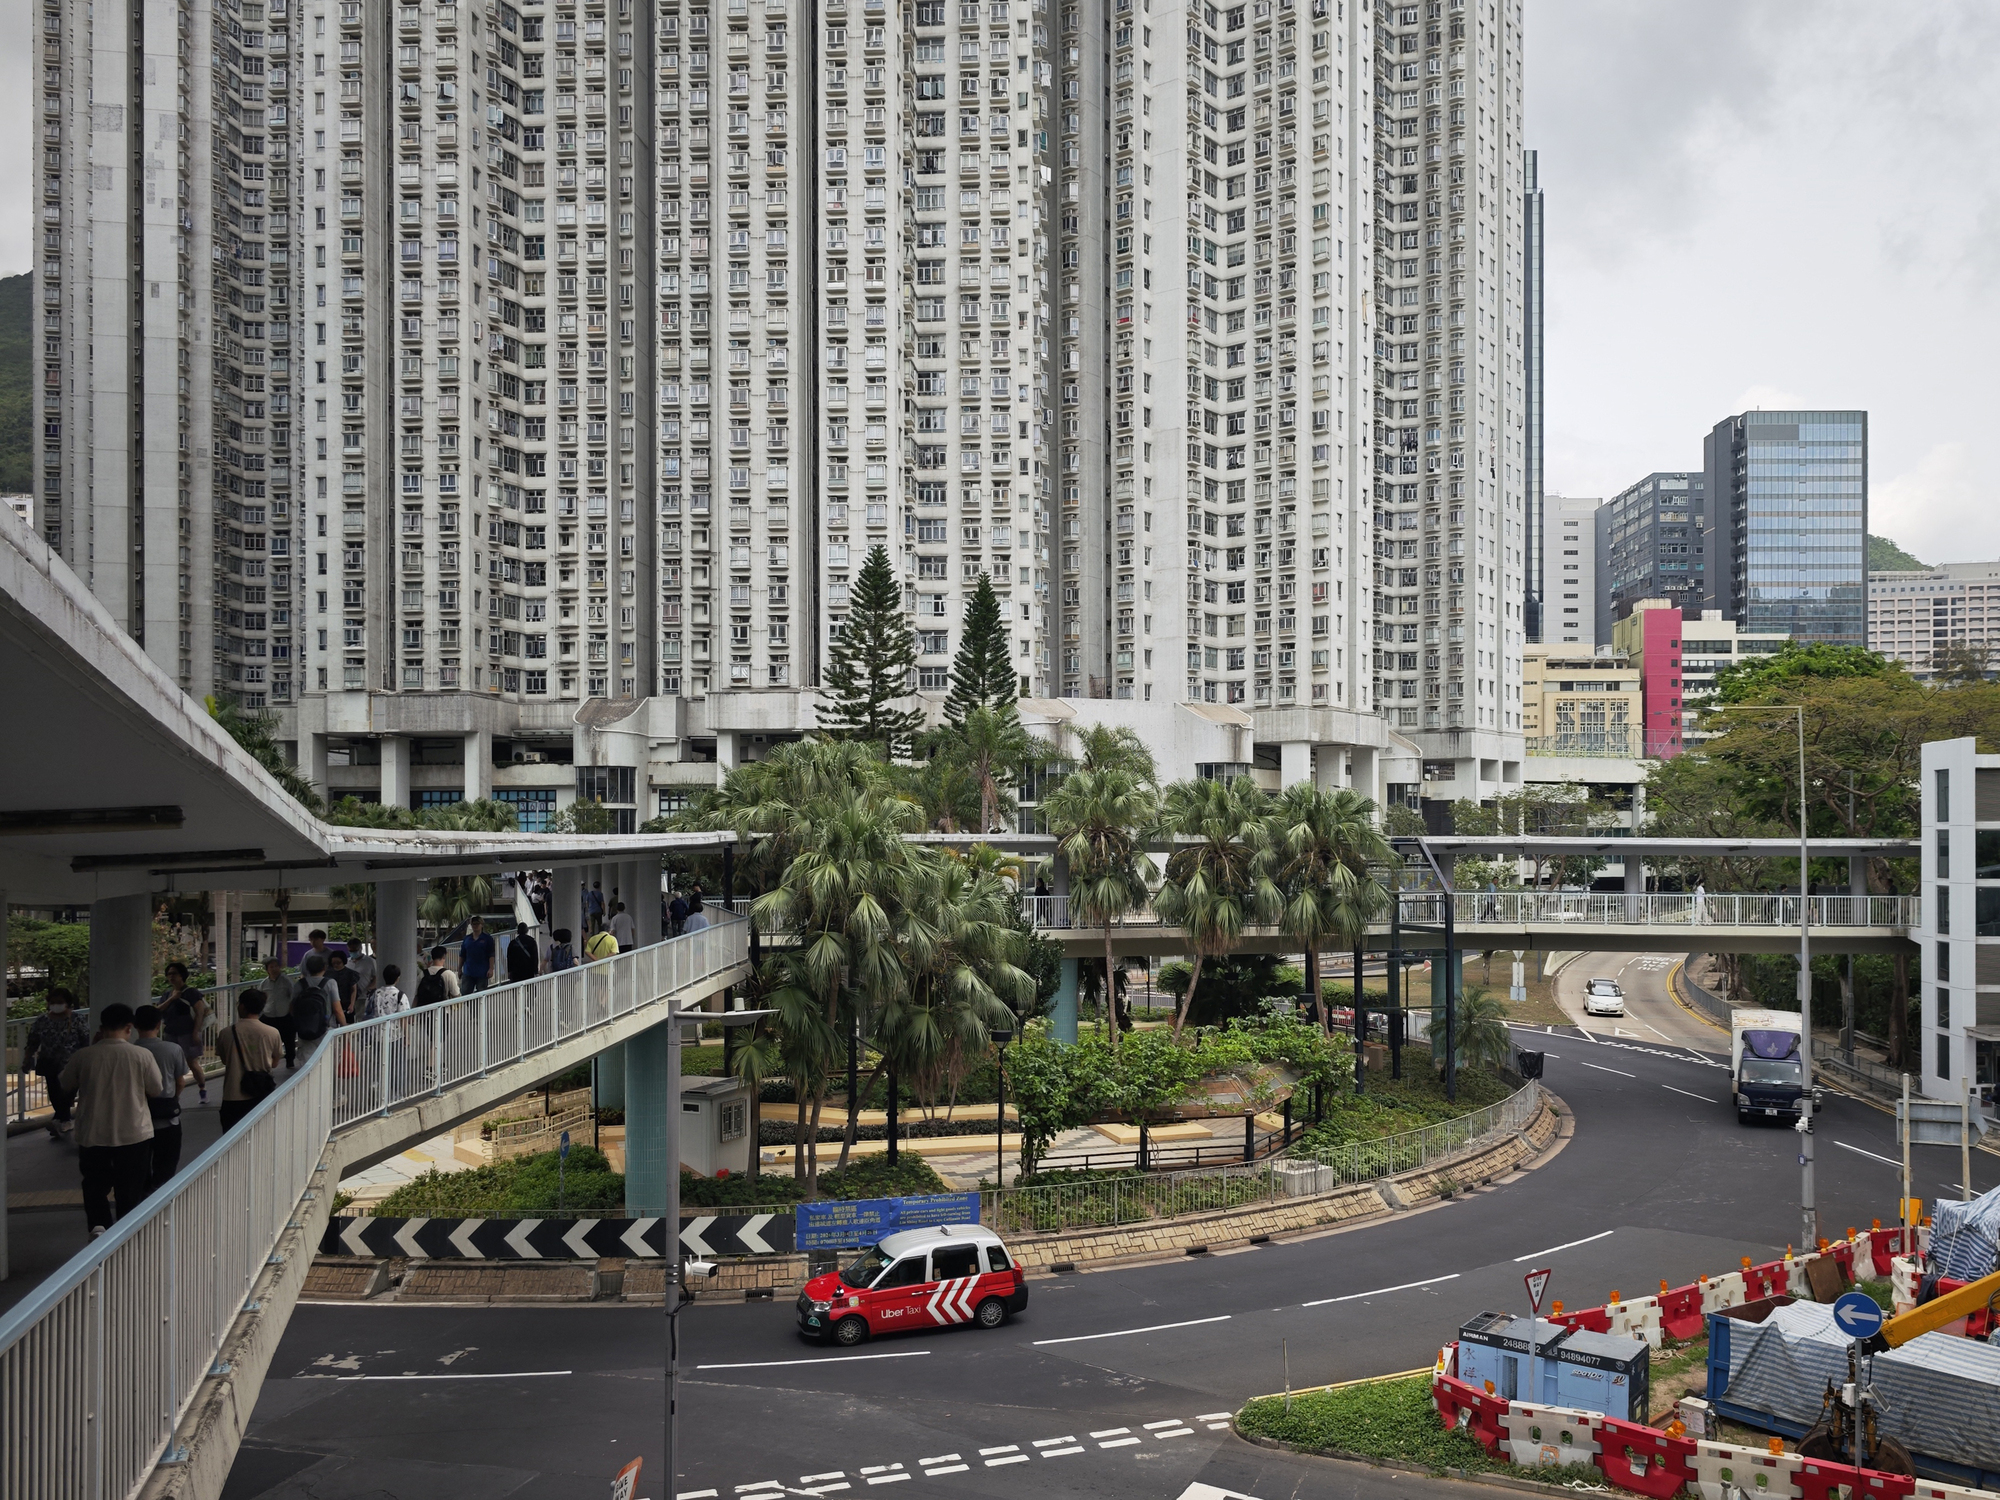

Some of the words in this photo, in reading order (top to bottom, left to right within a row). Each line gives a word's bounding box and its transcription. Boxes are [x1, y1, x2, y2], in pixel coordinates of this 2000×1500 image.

[881, 1308, 904, 1318] Uber
[905, 1306, 921, 1315] Taxi
[1462, 1332, 1488, 1342] AIRMAN
[1503, 1338, 1541, 1353] 2488882
[1560, 1351, 1600, 1366] 94894077
[616, 1476, 628, 1493] GIVE
